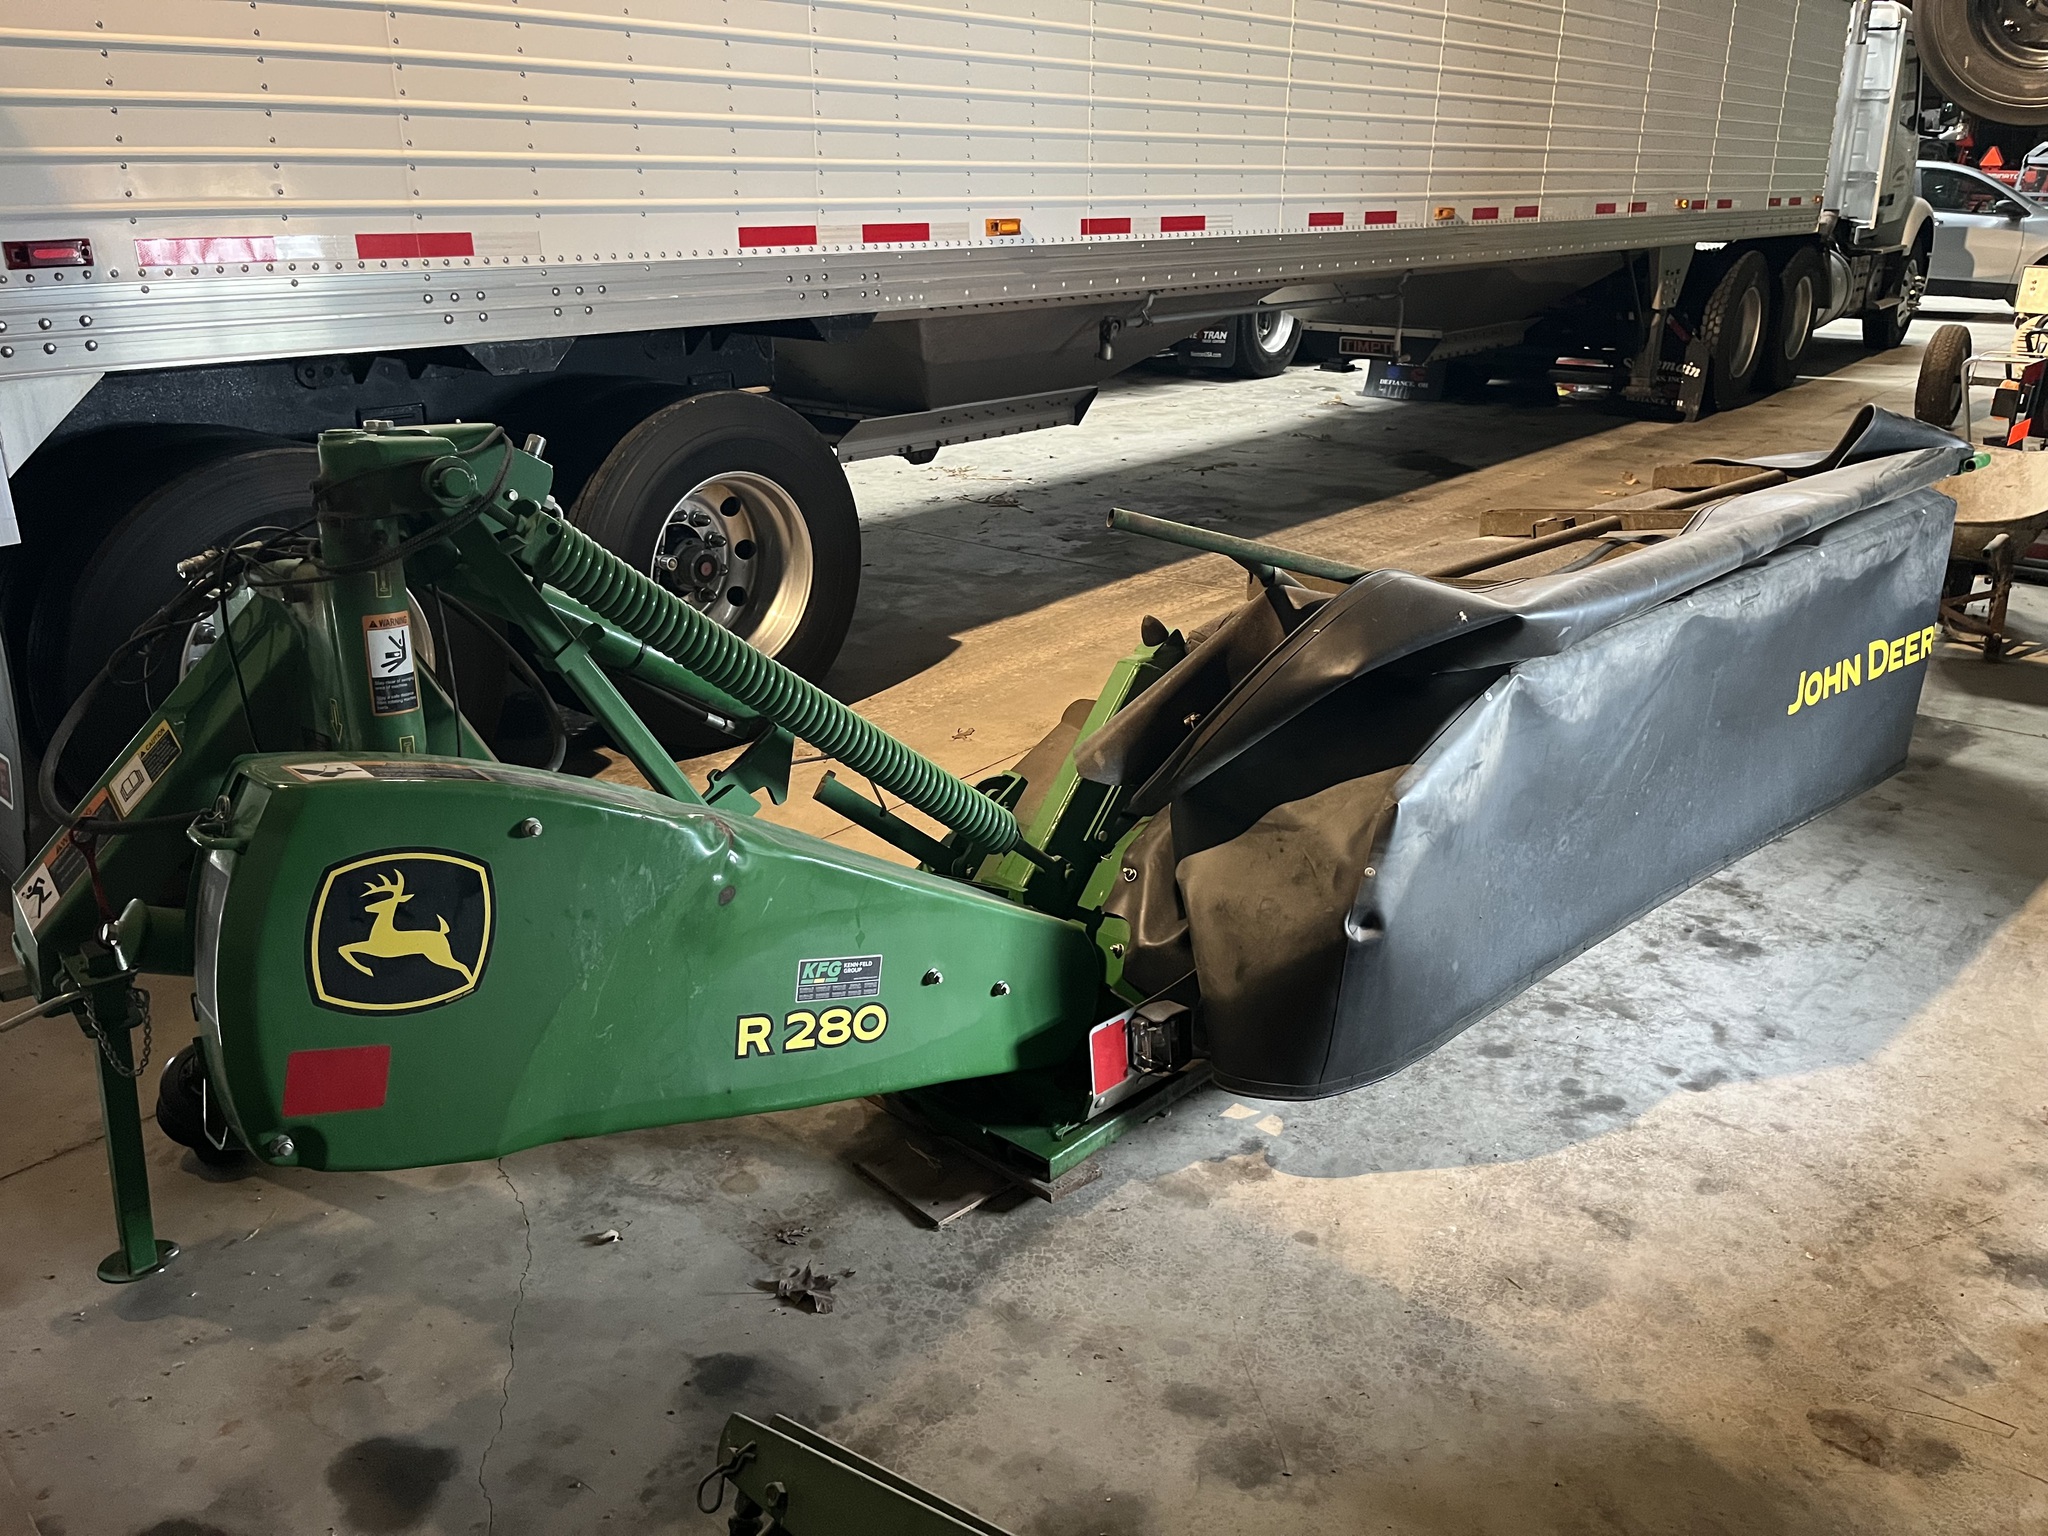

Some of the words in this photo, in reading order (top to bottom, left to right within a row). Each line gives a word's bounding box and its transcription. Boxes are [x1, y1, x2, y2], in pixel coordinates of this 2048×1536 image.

[378, 616, 407, 628] WARNING
[1787, 653, 1861, 716] JOHN
[145, 727, 166, 750] CAUTION
[802, 960, 842, 979] KFG
[736, 1014, 774, 1058] R
[783, 1002, 888, 1053] 280
